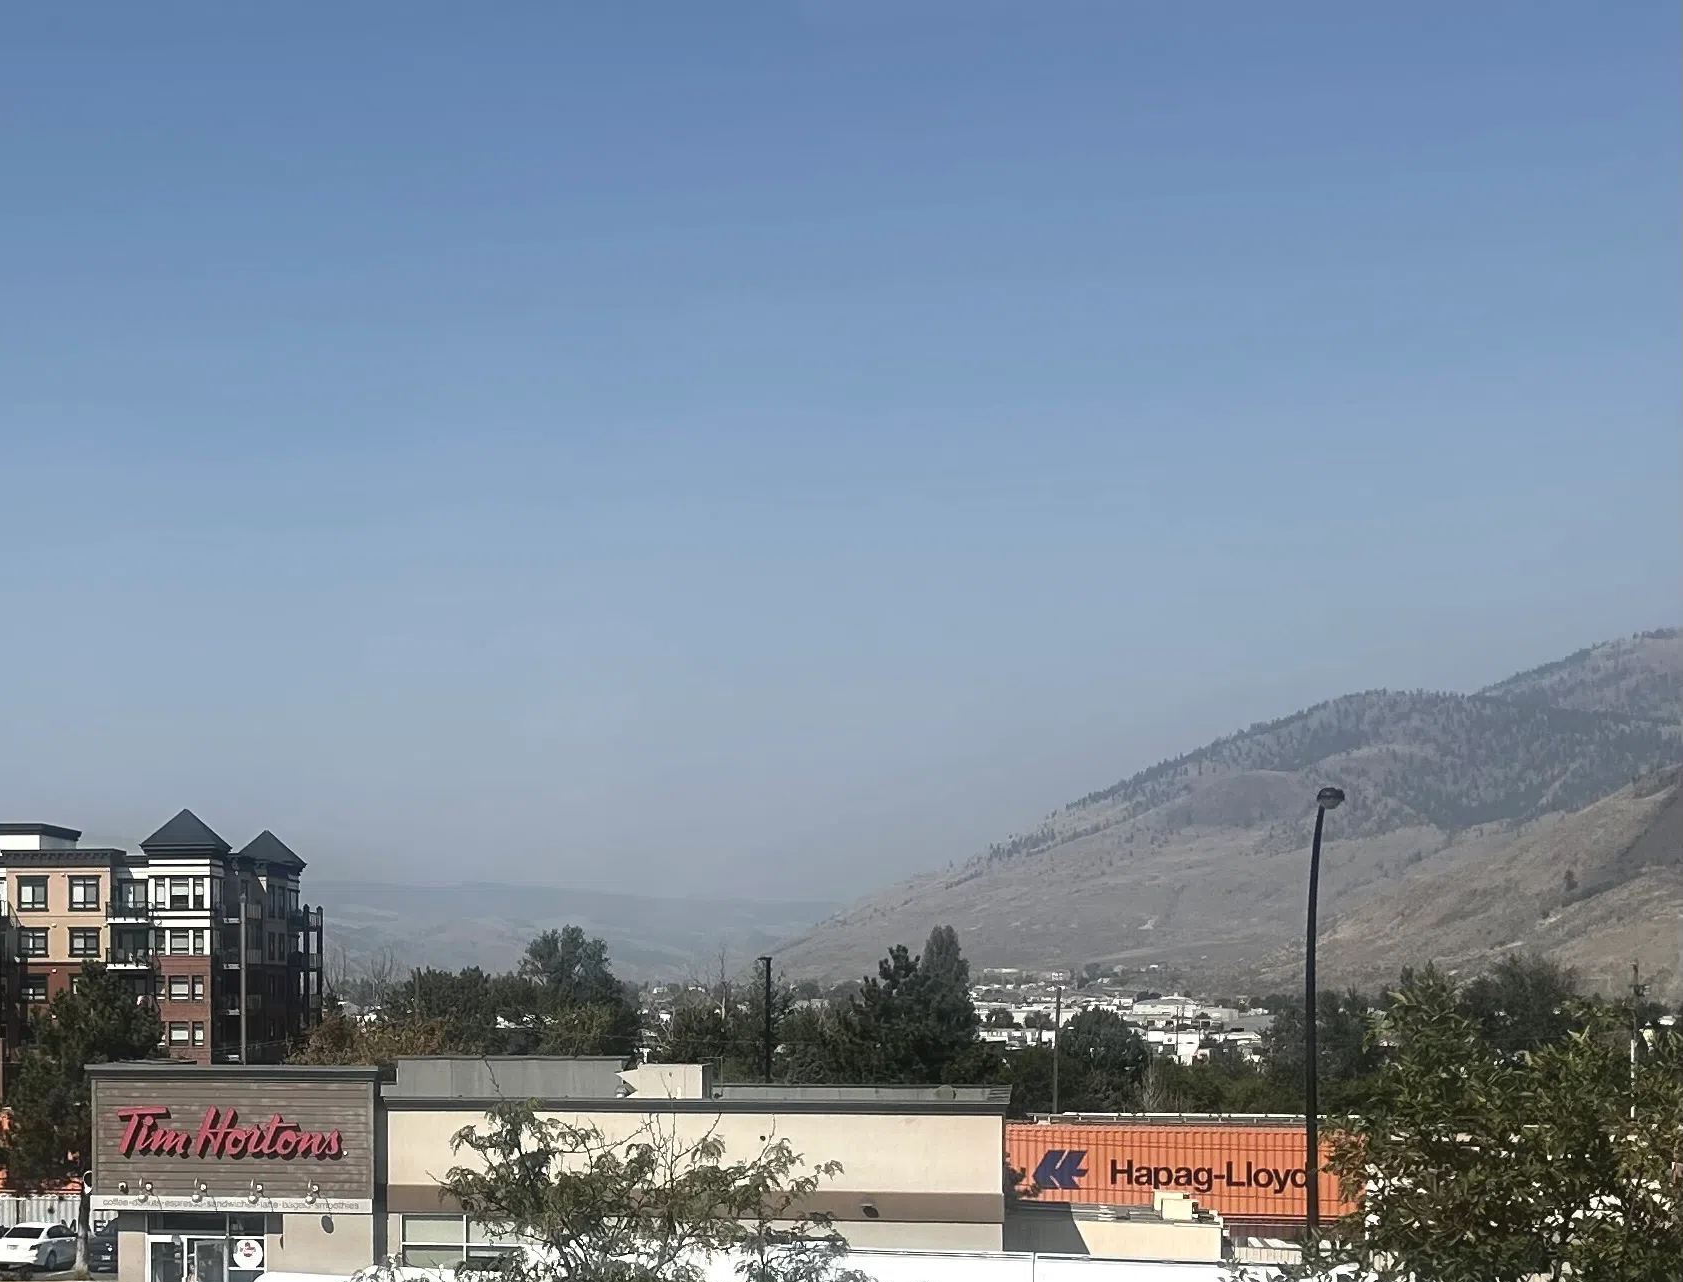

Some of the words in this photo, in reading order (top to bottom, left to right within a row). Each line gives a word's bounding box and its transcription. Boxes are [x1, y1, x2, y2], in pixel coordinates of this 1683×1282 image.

[118, 1106, 191, 1159] Tim
[193, 1105, 343, 1160] Hortons
[1110, 1159, 1309, 1194] Hapag-Lloyd
